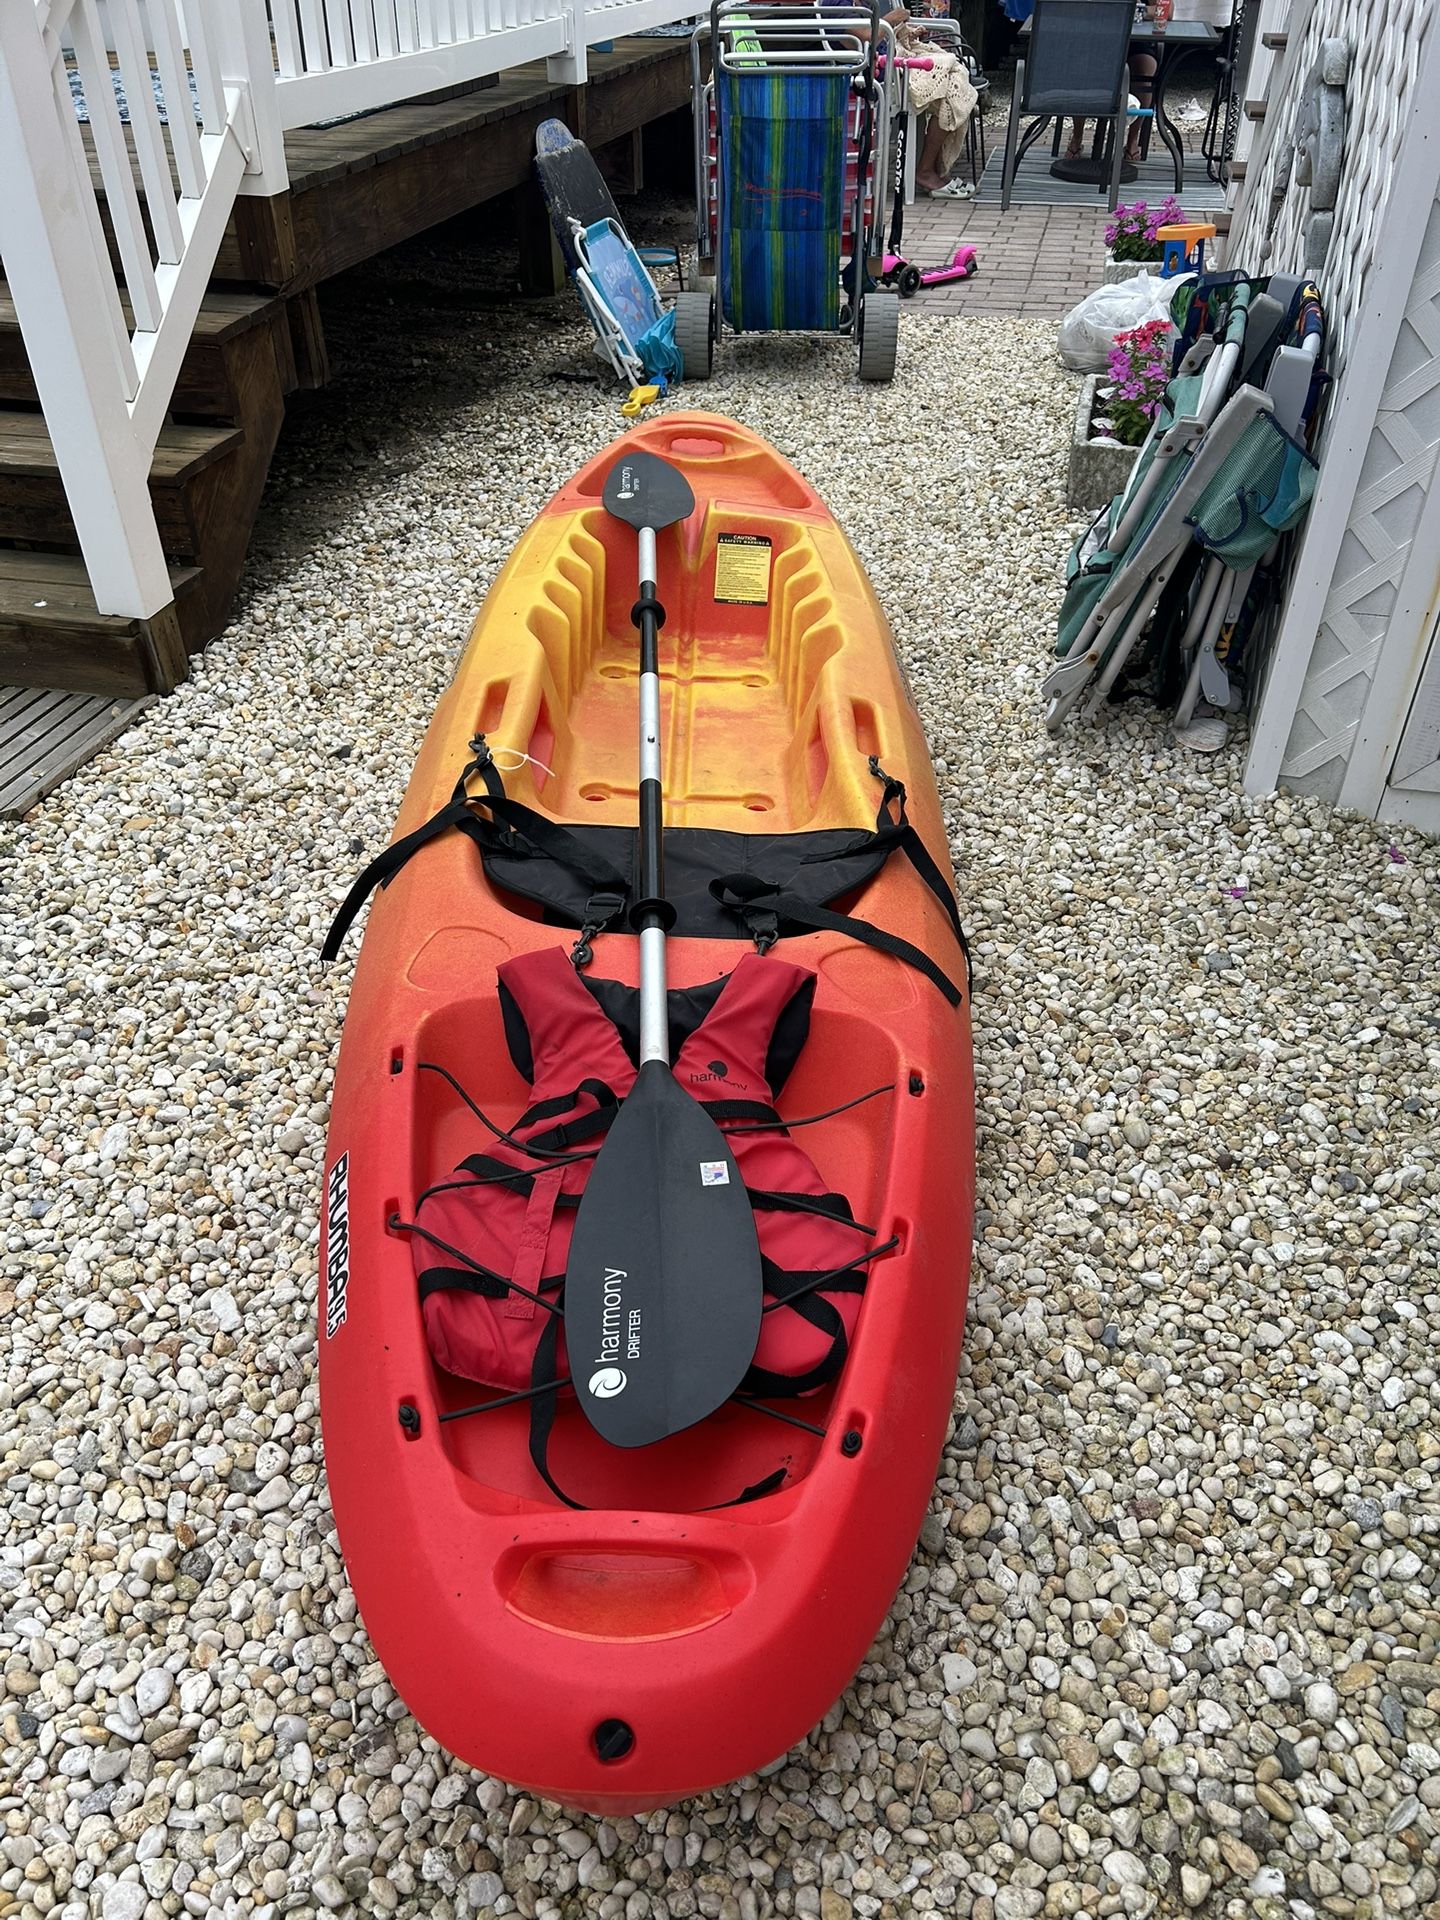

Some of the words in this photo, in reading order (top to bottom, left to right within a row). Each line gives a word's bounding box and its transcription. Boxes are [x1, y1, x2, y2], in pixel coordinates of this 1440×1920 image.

[328, 1153, 348, 1307] RHUMBA
[595, 1266, 627, 1364] harmony
[627, 1308, 641, 1360] DRIFTER
